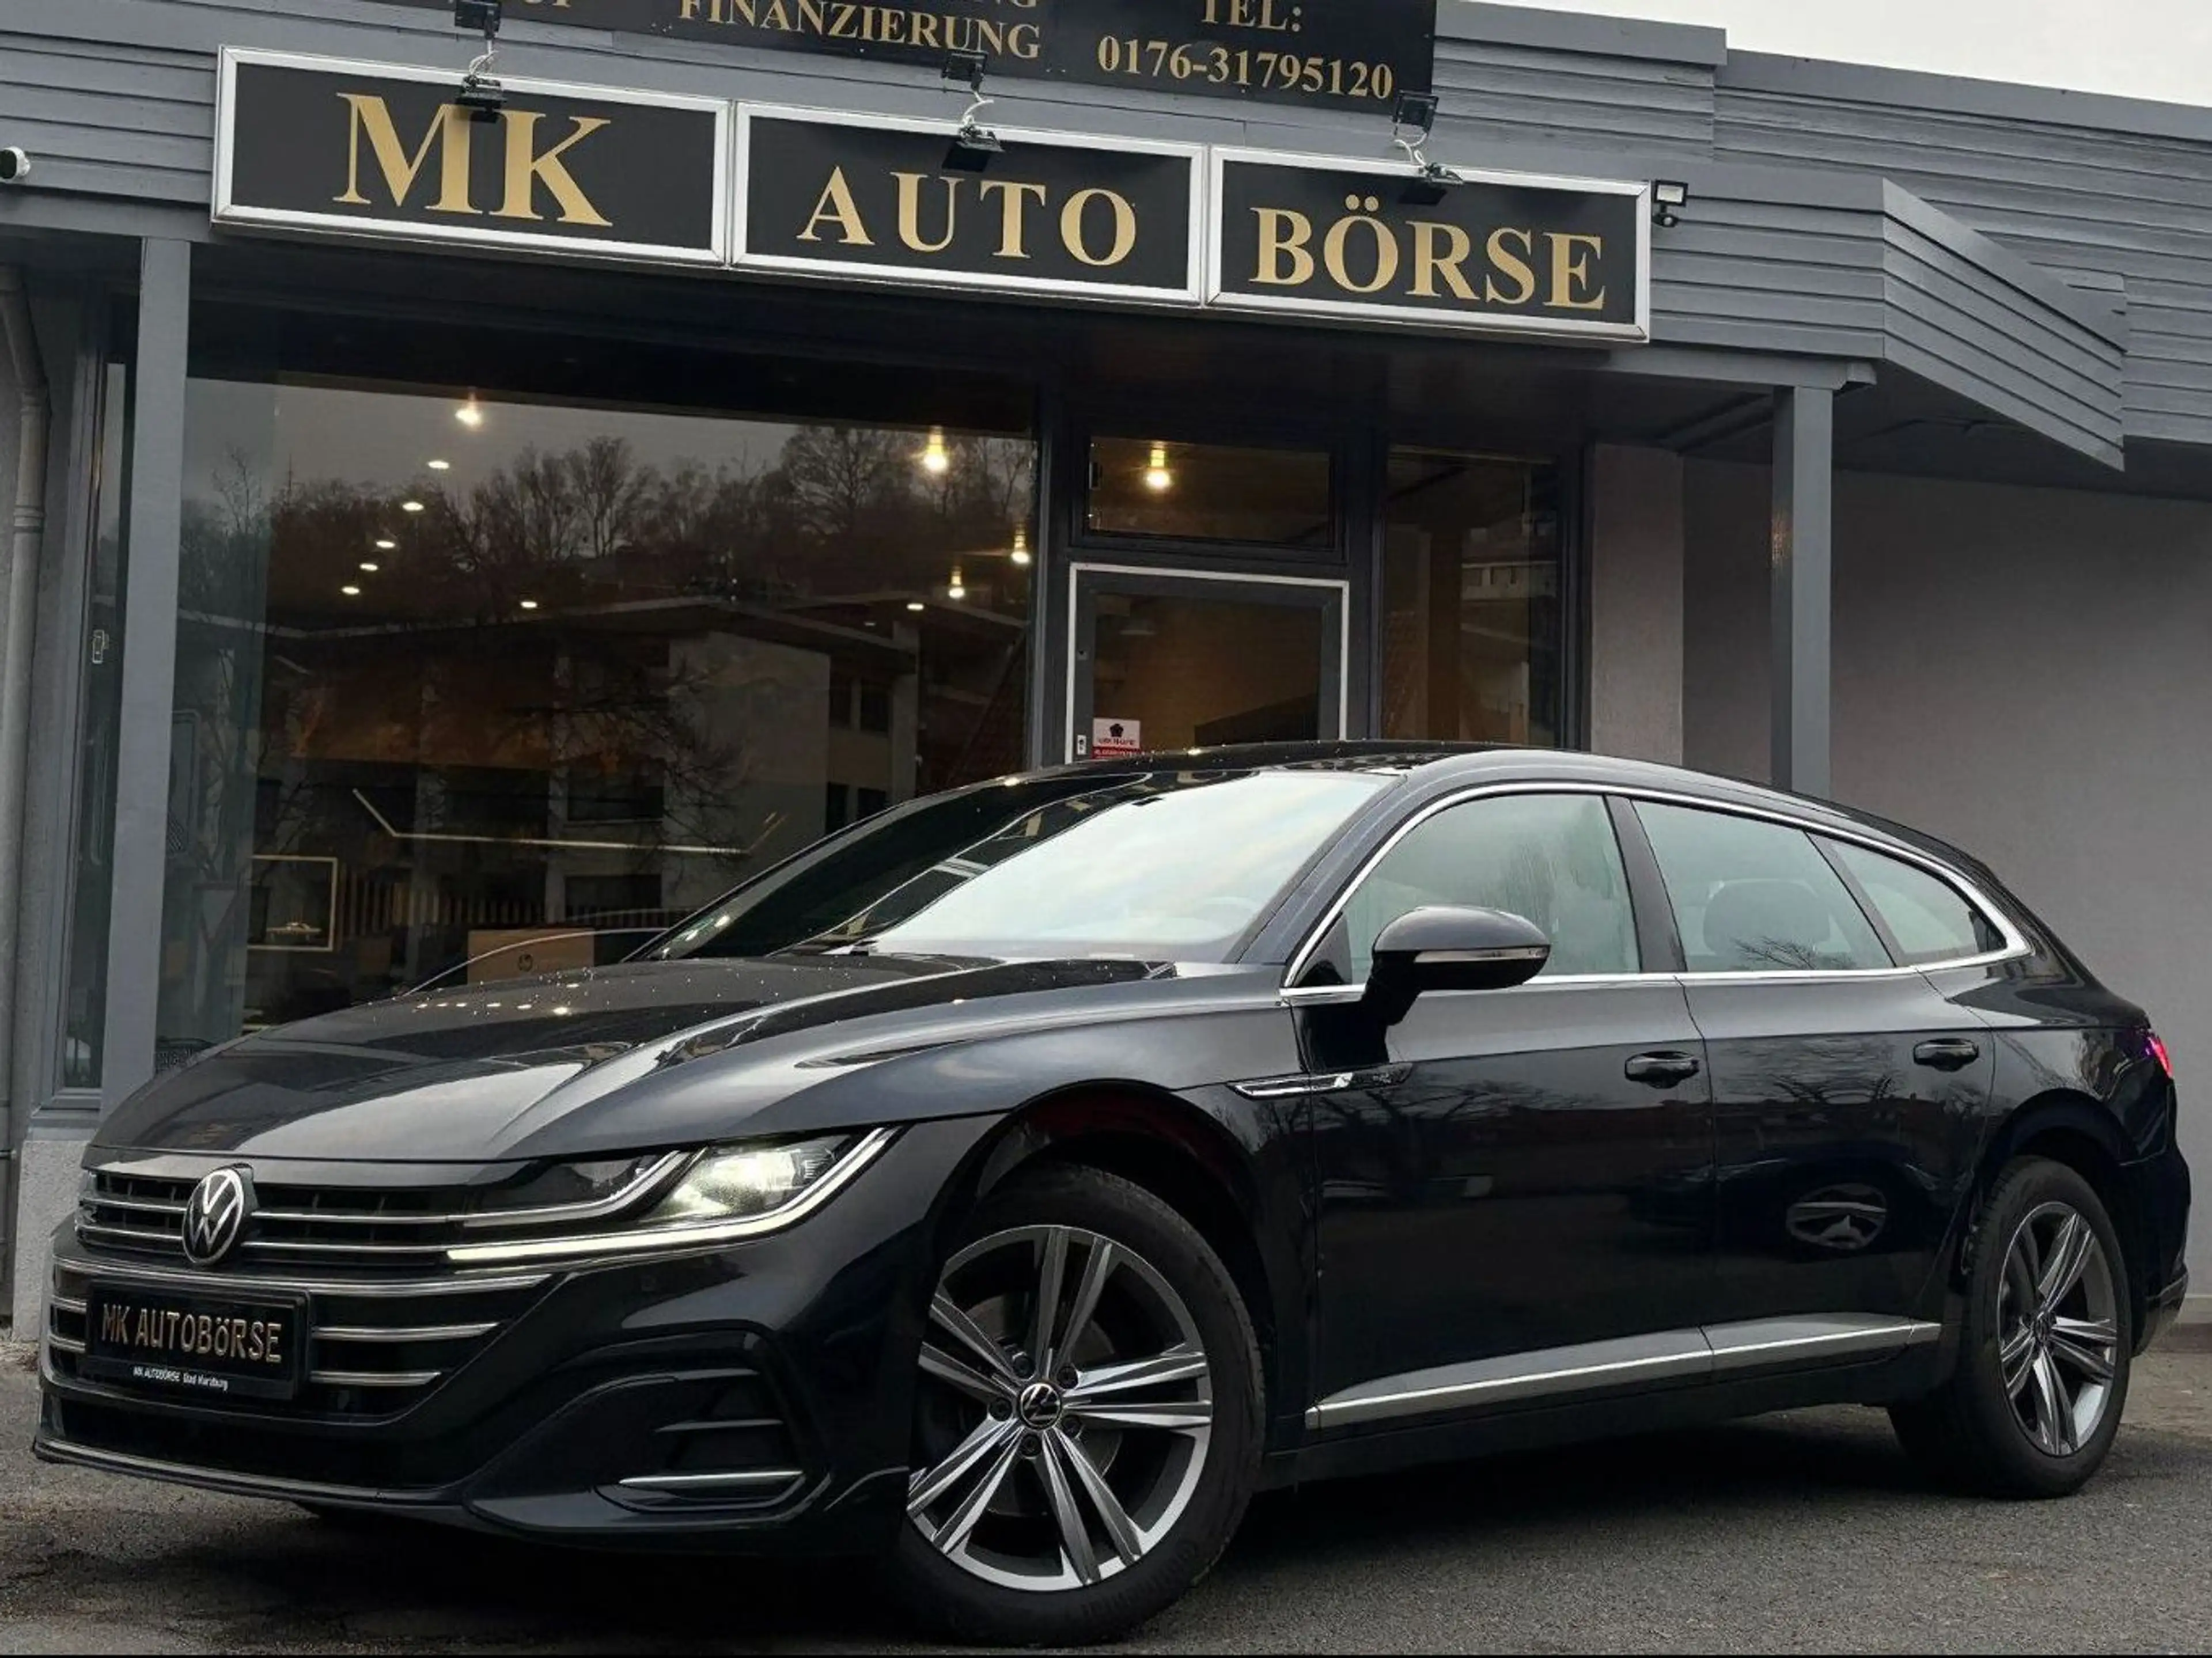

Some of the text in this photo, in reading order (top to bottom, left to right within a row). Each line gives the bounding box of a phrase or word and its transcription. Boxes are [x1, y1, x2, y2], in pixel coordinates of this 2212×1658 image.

[679, 0, 1040, 59] FINANZIERUNG
[1201, 0, 1302, 32] TEL:
[1097, 35, 1393, 100] 0176-31795120
[332, 92, 1605, 310] MK AUTO BÖRSE
[101, 1303, 282, 1363] MK AUTOBÖRSE
